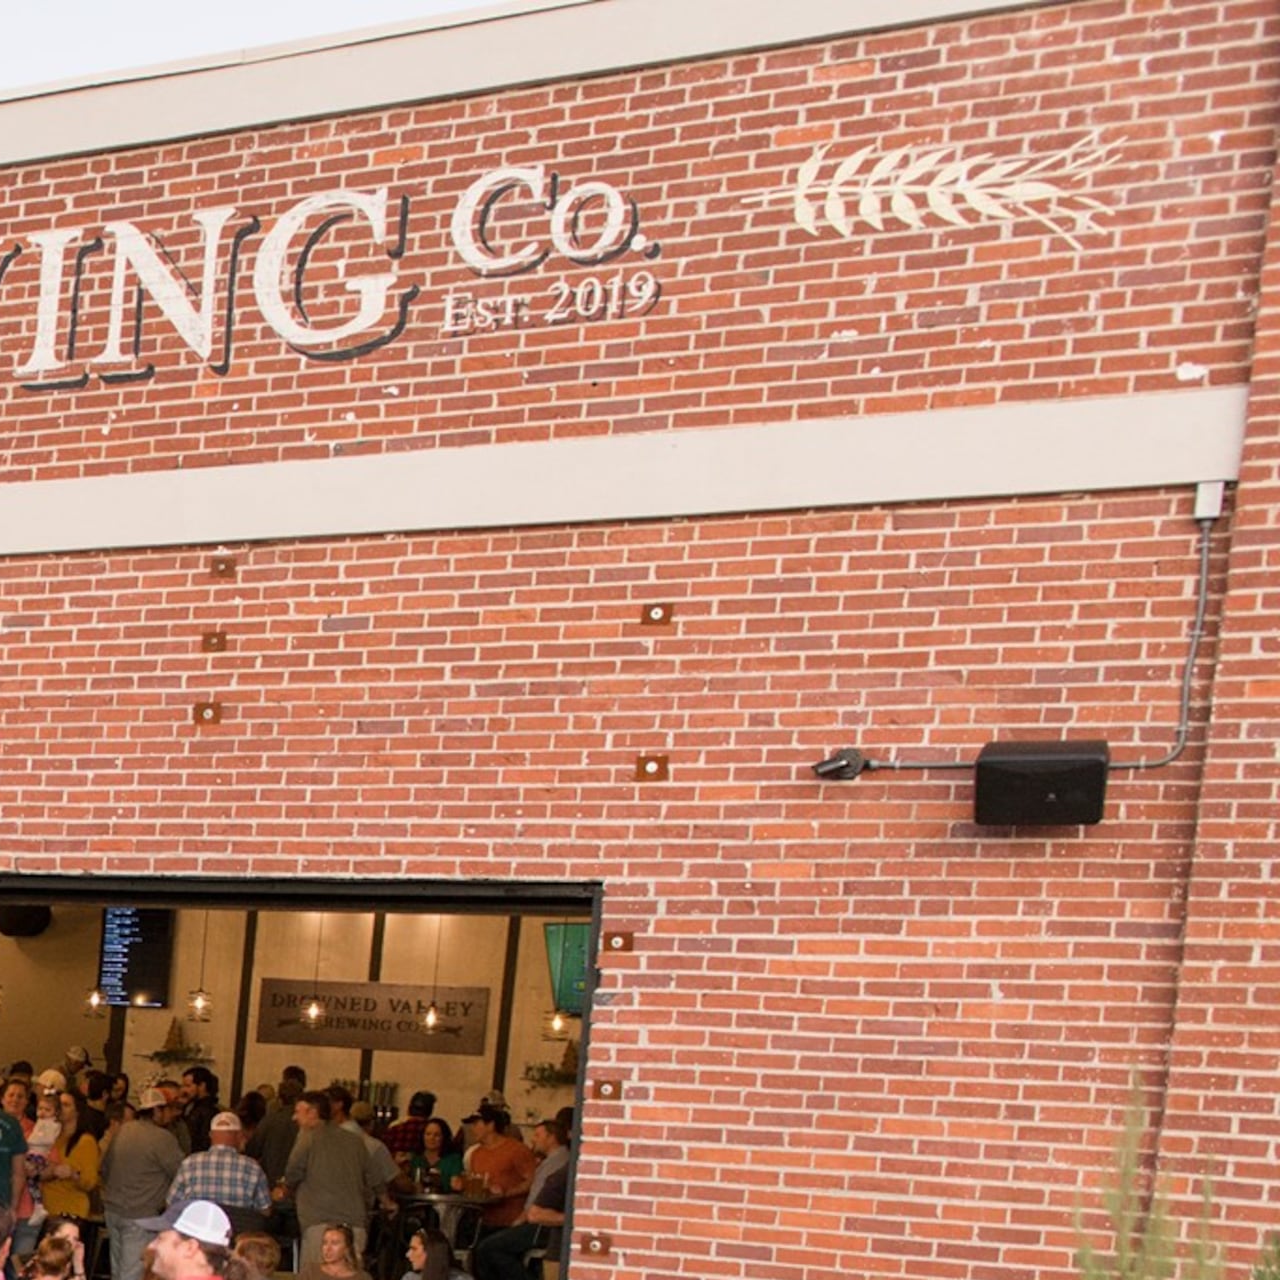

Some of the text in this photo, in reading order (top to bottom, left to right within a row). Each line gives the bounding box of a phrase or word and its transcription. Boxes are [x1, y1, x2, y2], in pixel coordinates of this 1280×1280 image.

[543, 271, 657, 323] 2019
[389, 998, 473, 1018] VALEY
[316, 1015, 391, 1033] REWING
